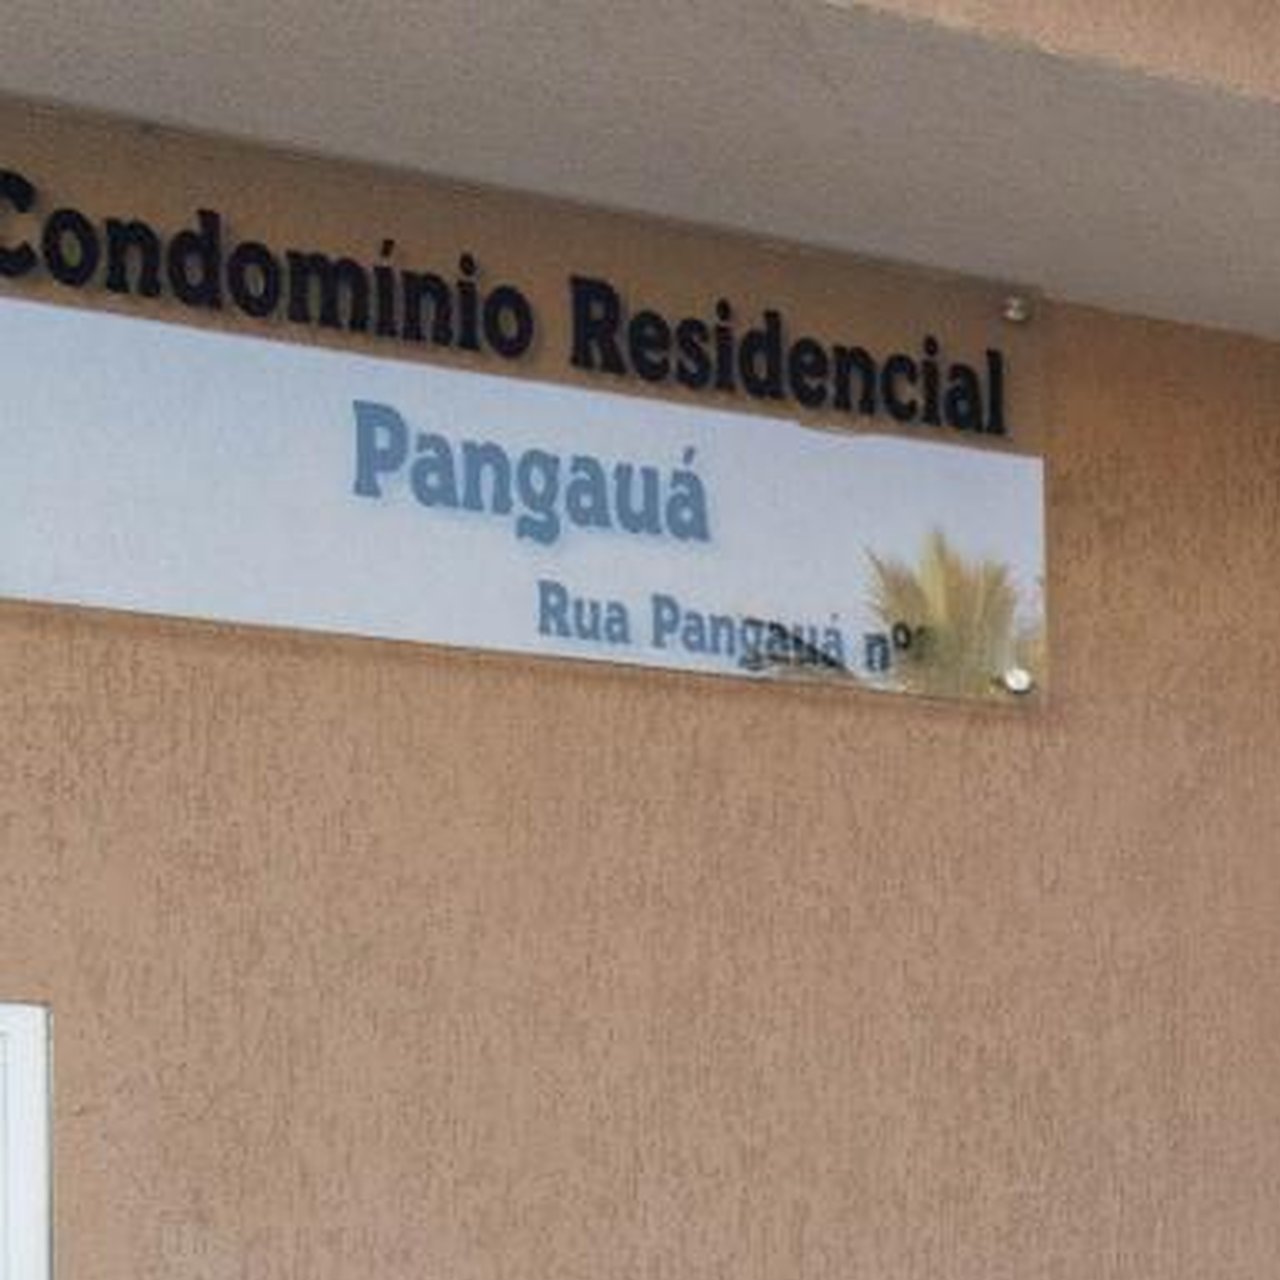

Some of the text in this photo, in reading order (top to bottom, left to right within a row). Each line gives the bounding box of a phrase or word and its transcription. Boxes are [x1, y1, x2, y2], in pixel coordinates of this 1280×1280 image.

[0, 169, 1007, 435] Condomínio Residencial
[353, 400, 710, 544] Pangauá
[537, 580, 631, 644] Rua
[651, 594, 846, 671] Pangauá
